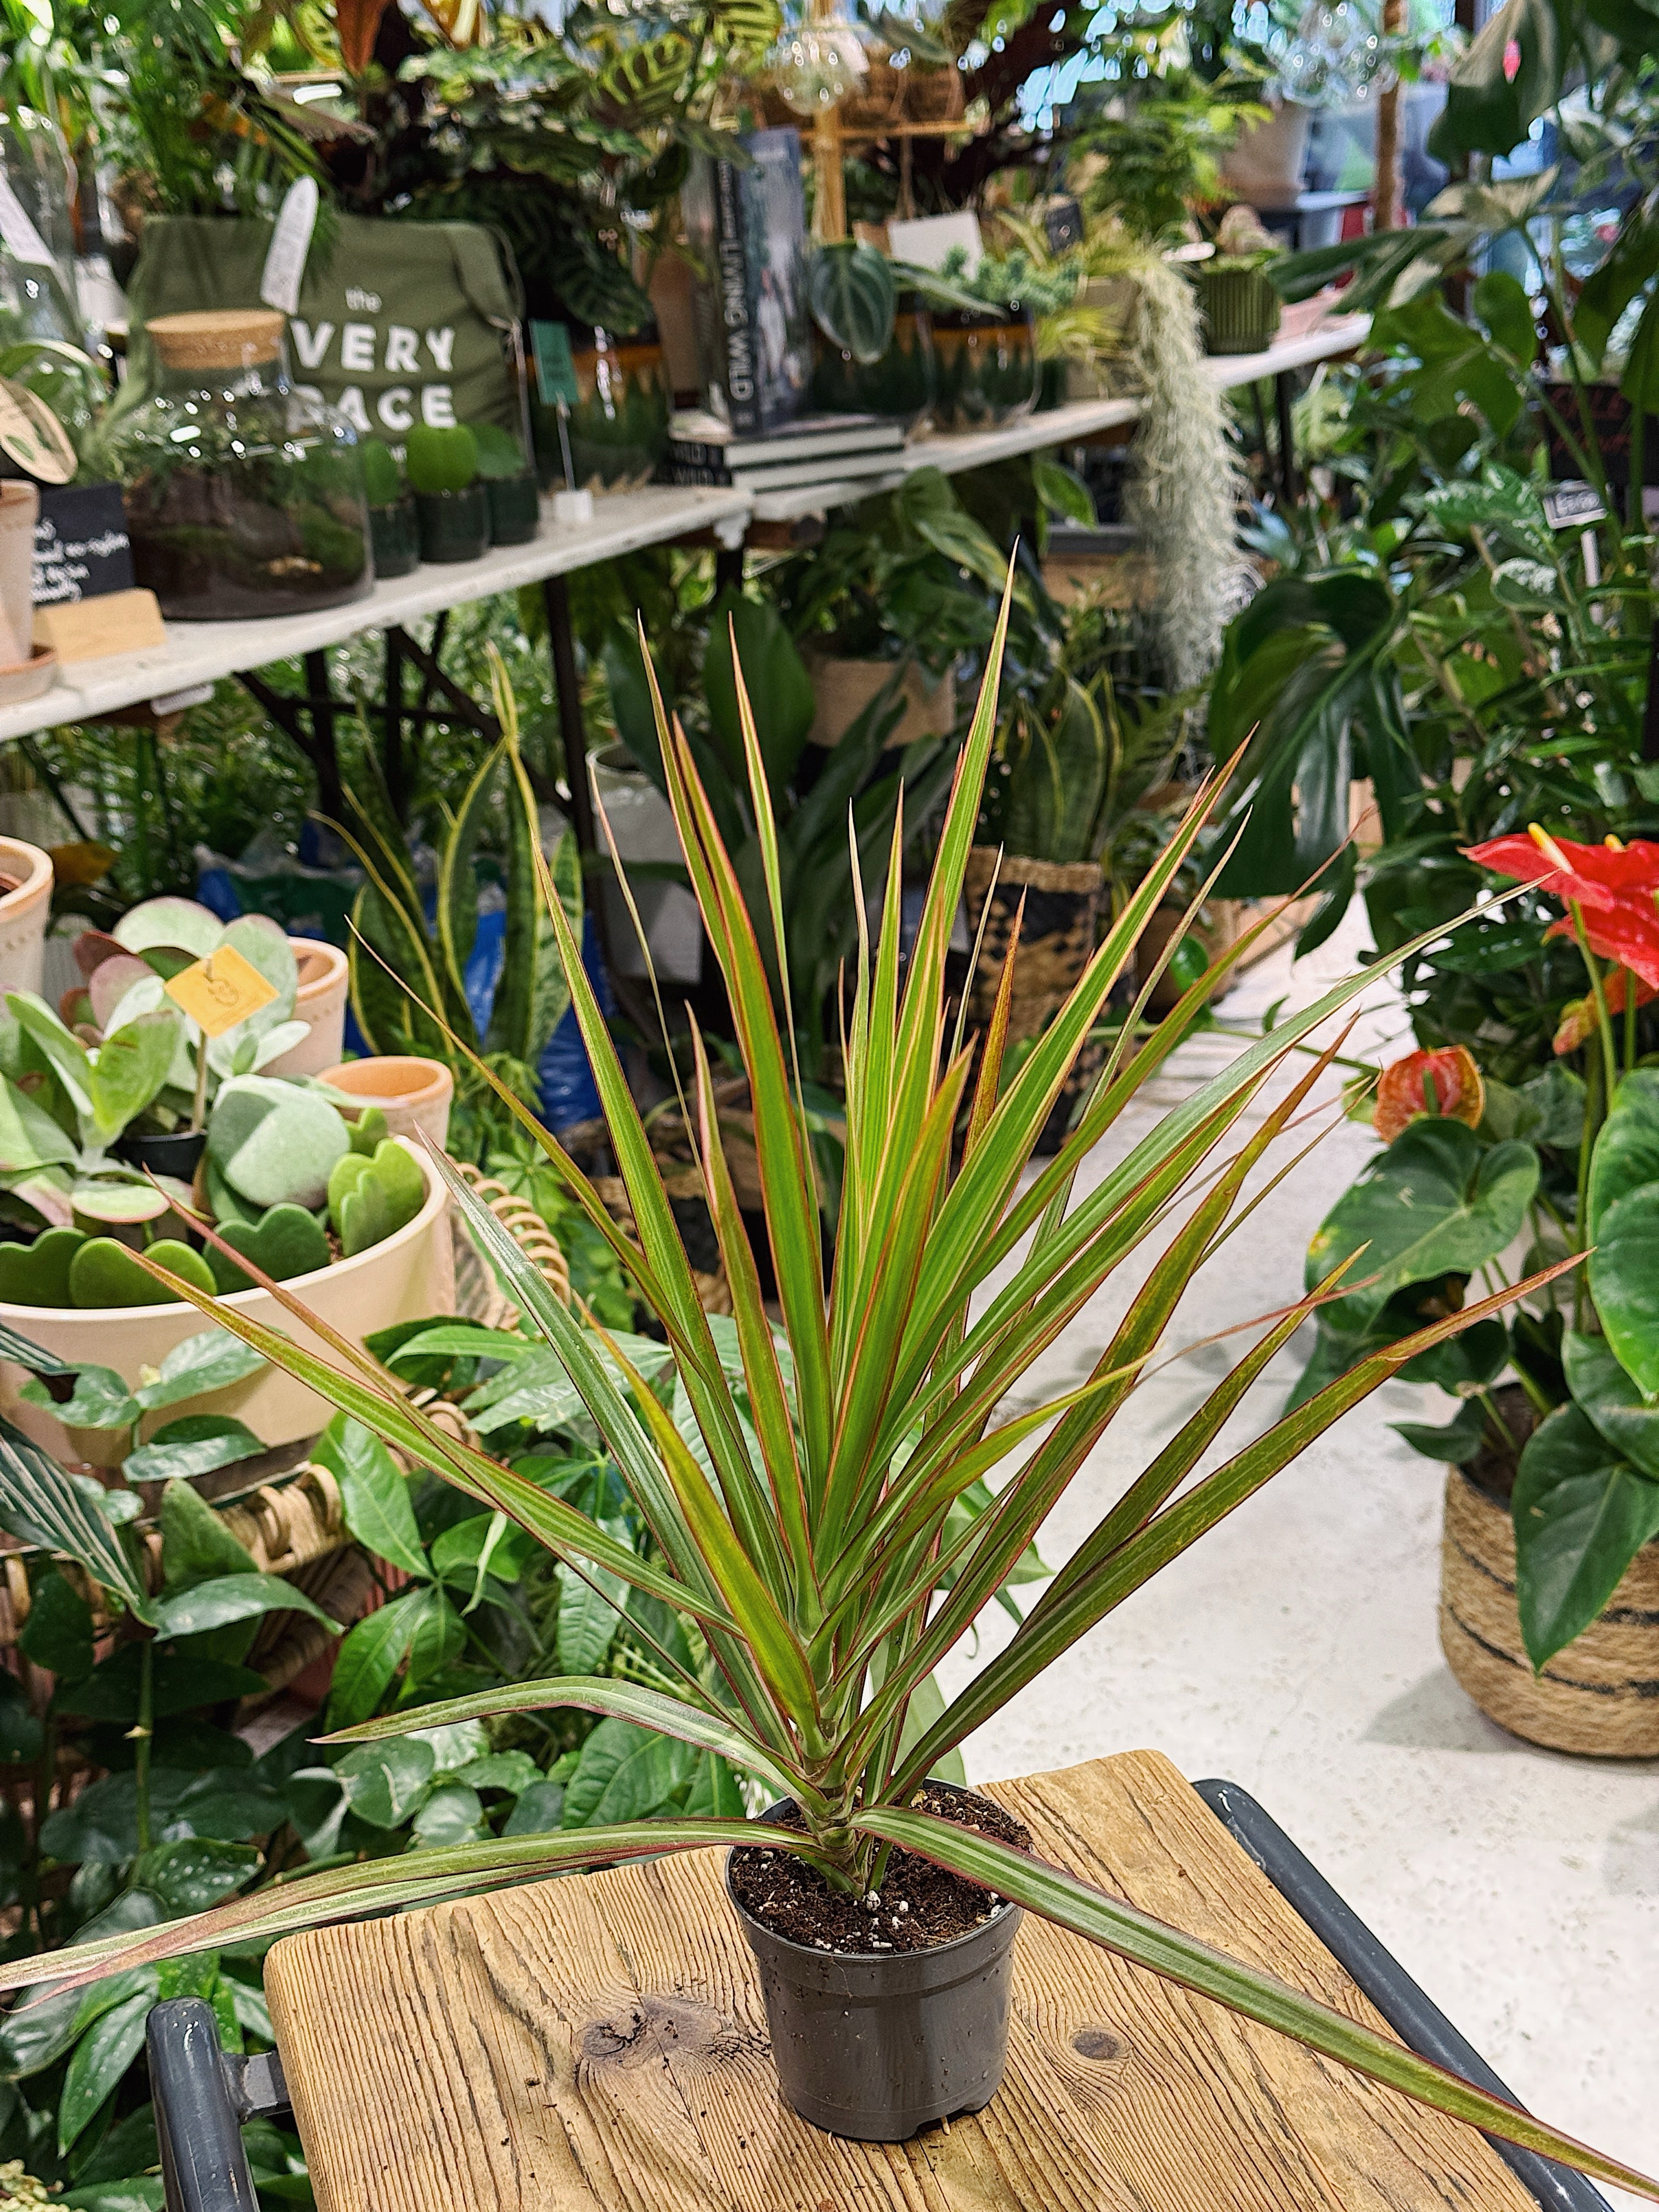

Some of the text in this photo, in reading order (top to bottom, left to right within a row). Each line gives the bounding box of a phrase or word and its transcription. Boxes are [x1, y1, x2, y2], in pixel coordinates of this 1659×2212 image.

[345, 286, 382, 312] the
[719, 239, 748, 327] LIVING
[727, 329, 754, 401] WILD
